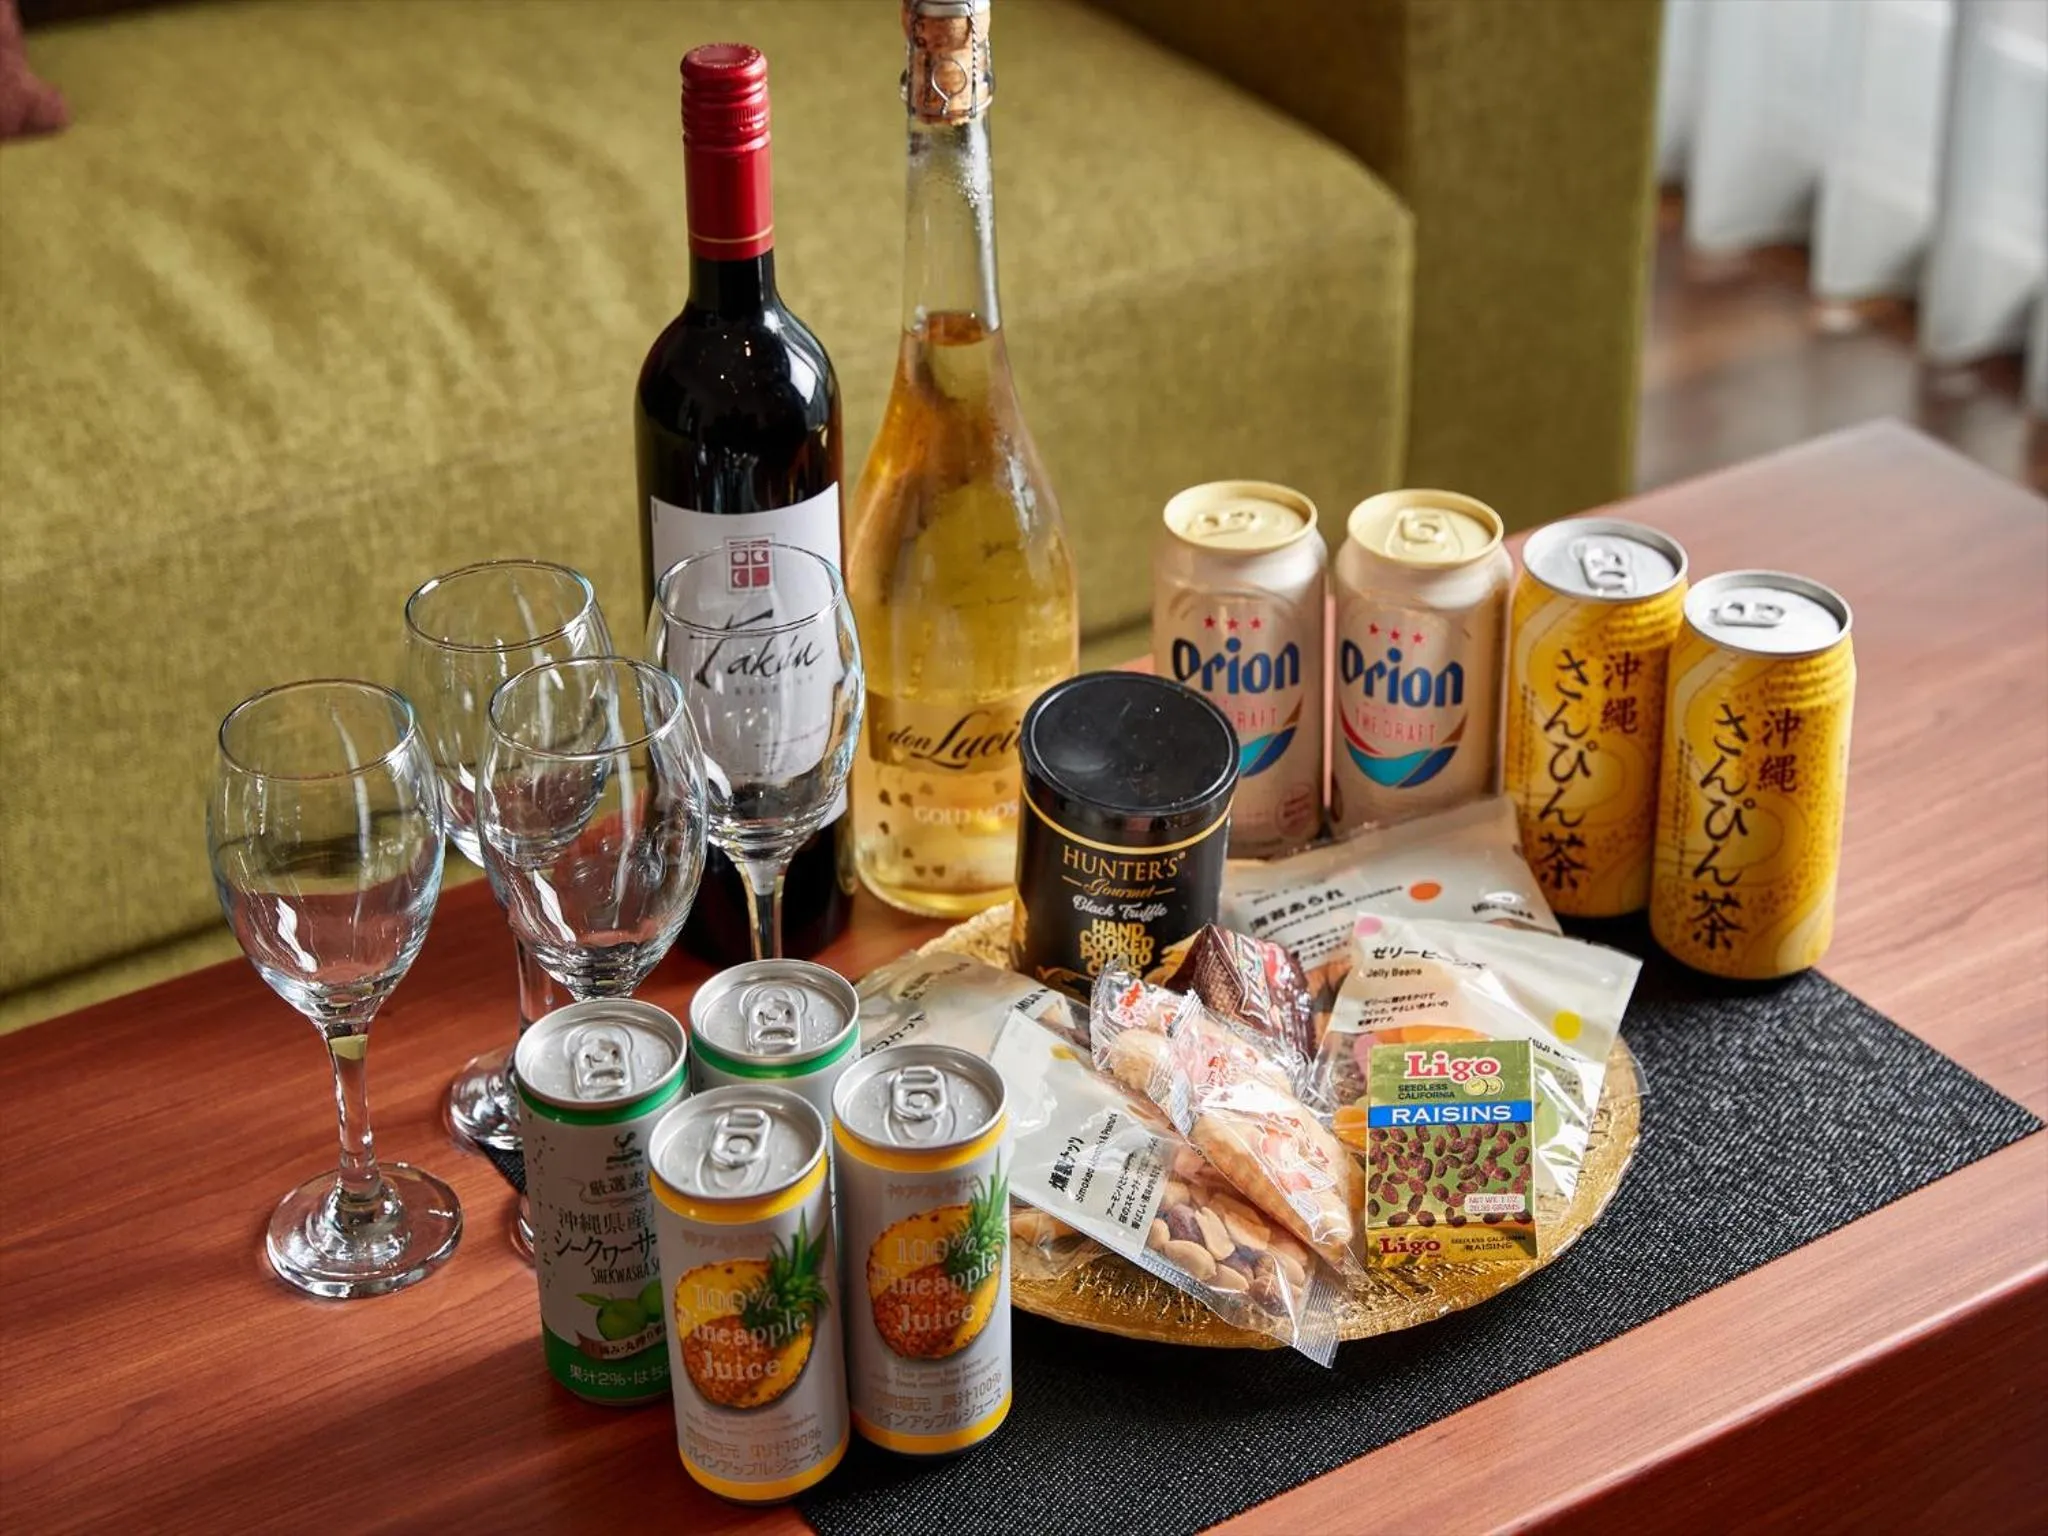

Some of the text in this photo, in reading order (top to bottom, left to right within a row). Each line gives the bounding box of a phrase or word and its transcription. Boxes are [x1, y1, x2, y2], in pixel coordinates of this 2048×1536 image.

[1172, 637, 1301, 694] Orion
[1341, 639, 1464, 708] Orion
[1600, 651, 1644, 734] 沖縄
[886, 725, 931, 750] don
[1756, 707, 1803, 794] 沖縄
[1536, 648, 1600, 891] さんぴん茶
[913, 805, 971, 826] GOLD
[1690, 703, 1758, 951] さんぴん茶
[1062, 845, 1180, 881] HUNTER'S
[1082, 878, 1157, 899] Gourmet
[1072, 894, 1169, 922] Black Truffle
[1079, 929, 1156, 952] COOKED
[1091, 918, 1147, 939] HAND
[1366, 968, 1390, 979] Jelly
[1404, 1050, 1501, 1083] Ligo
[1398, 1083, 1449, 1092] SEEDLESS
[1398, 1091, 1456, 1100] CALIFORNIA
[1391, 1105, 1512, 1125] RAISINS
[894, 1233, 980, 1267] 100%
[1379, 1237, 1442, 1257] Ligo
[872, 1250, 999, 1297] Pineapple
[693, 1283, 779, 1313] 100%
[676, 1307, 808, 1352] Pineapple
[897, 1303, 976, 1334] Juice
[702, 1349, 783, 1382] Juice
